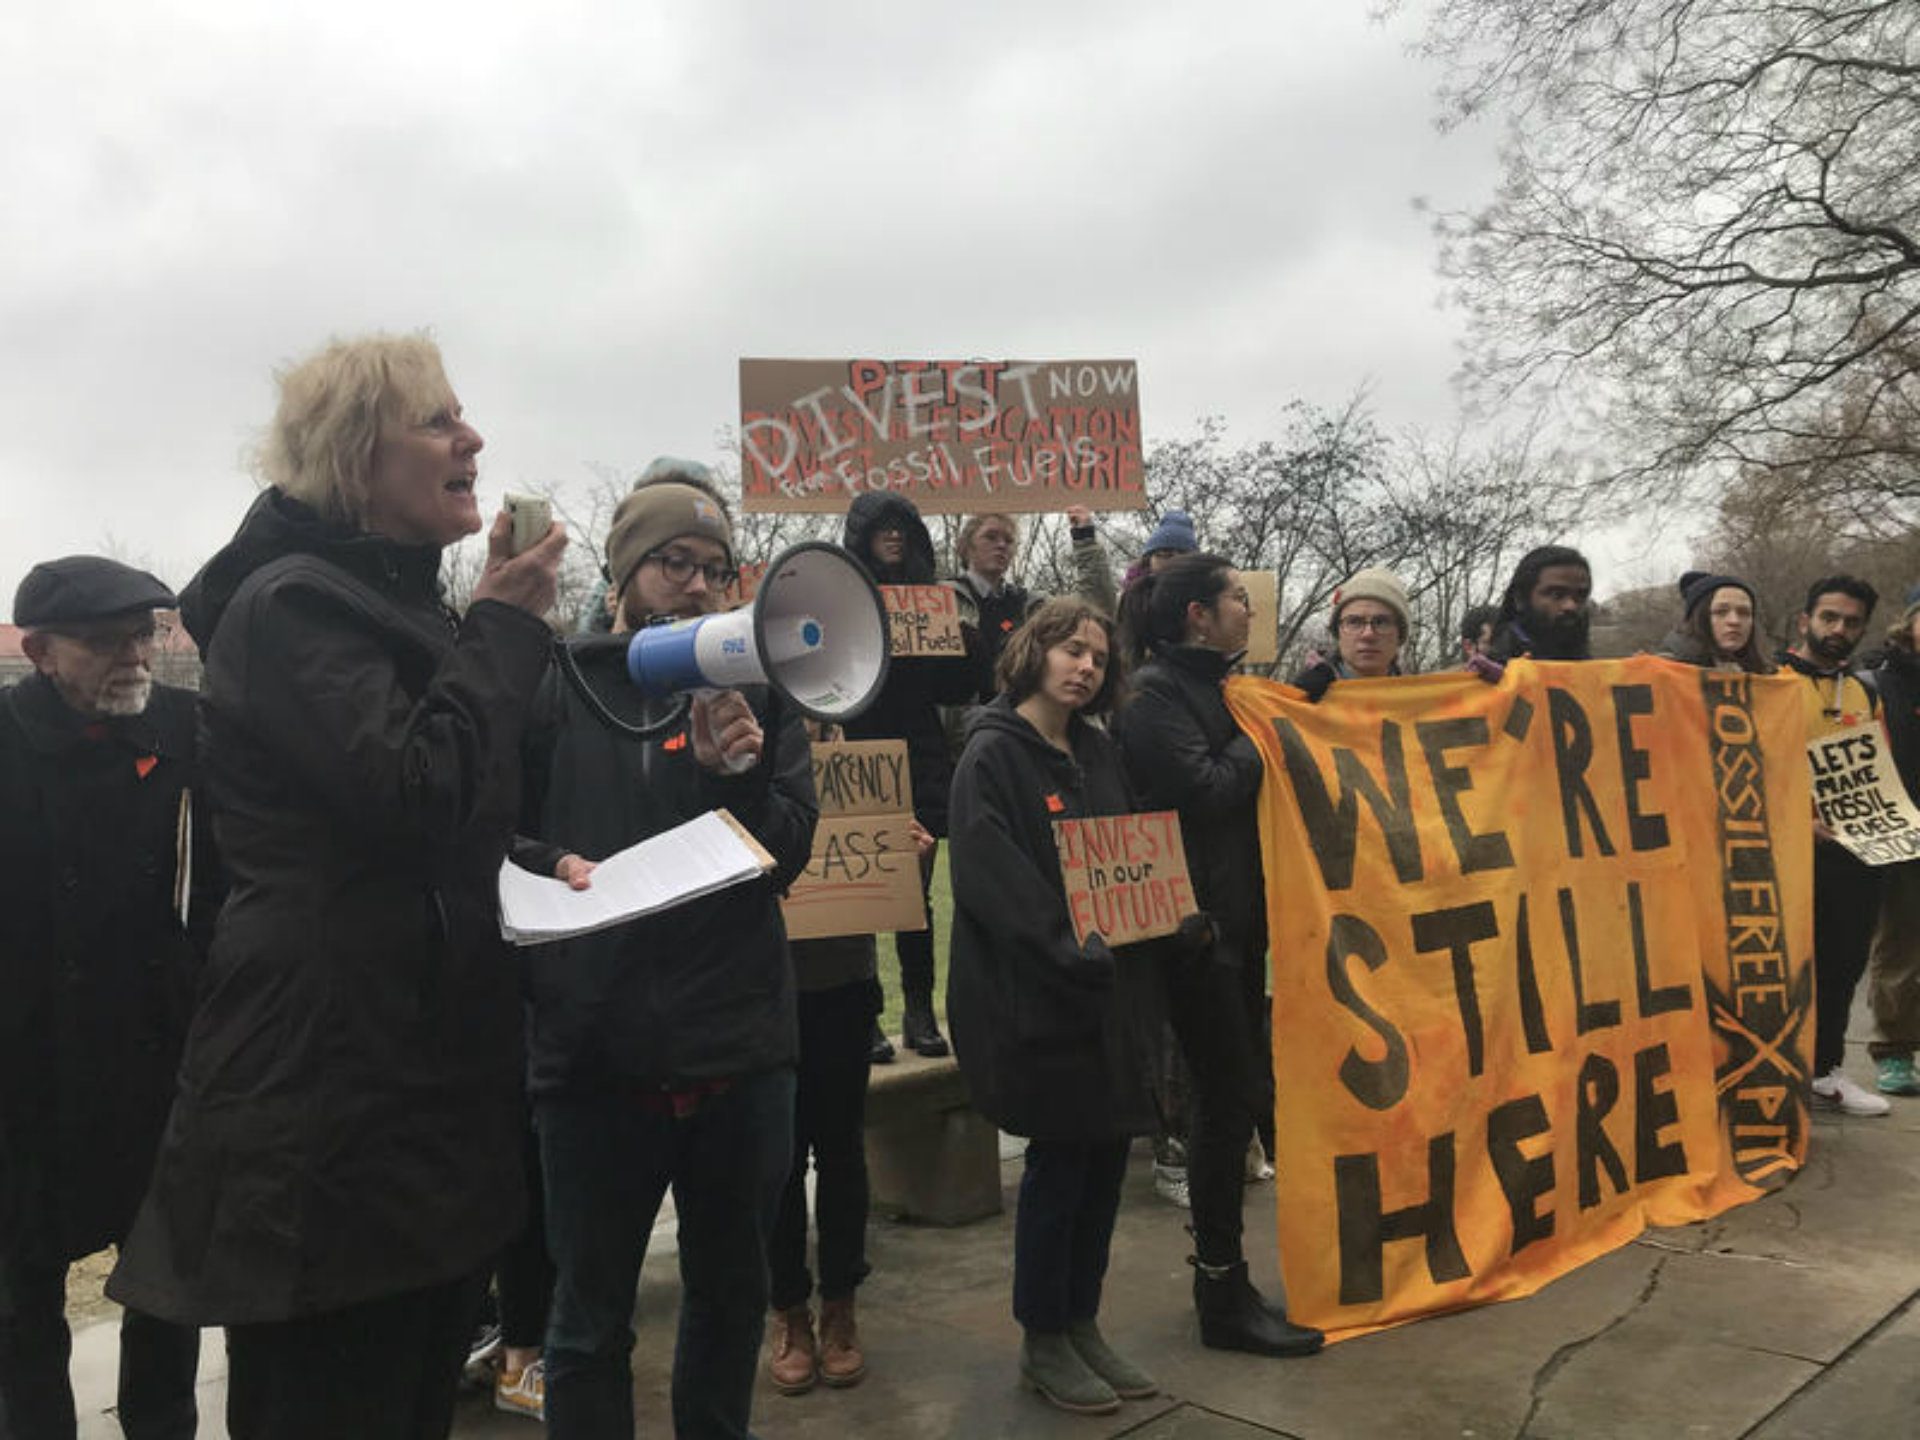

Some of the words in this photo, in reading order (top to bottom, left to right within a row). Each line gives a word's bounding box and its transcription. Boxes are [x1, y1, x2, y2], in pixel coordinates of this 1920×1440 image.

[741, 365, 1044, 477] DIVEST
[1049, 366, 1135, 398] NOW
[1273, 683, 1671, 891] WE'RE
[1707, 671, 1769, 868] FOSSIL
[1816, 764, 1879, 799] MAKE
[1819, 786, 1897, 826] FOSSIL
[1059, 811, 1175, 869] INVEST
[1843, 810, 1909, 838] FUELS
[1070, 877, 1187, 942] FUTURE
[1088, 866, 1107, 891] in
[1113, 863, 1153, 883] our
[1729, 880, 1788, 1018] FREE
[1325, 881, 1693, 1111] STILL
[1334, 1042, 1688, 1306] HERE
